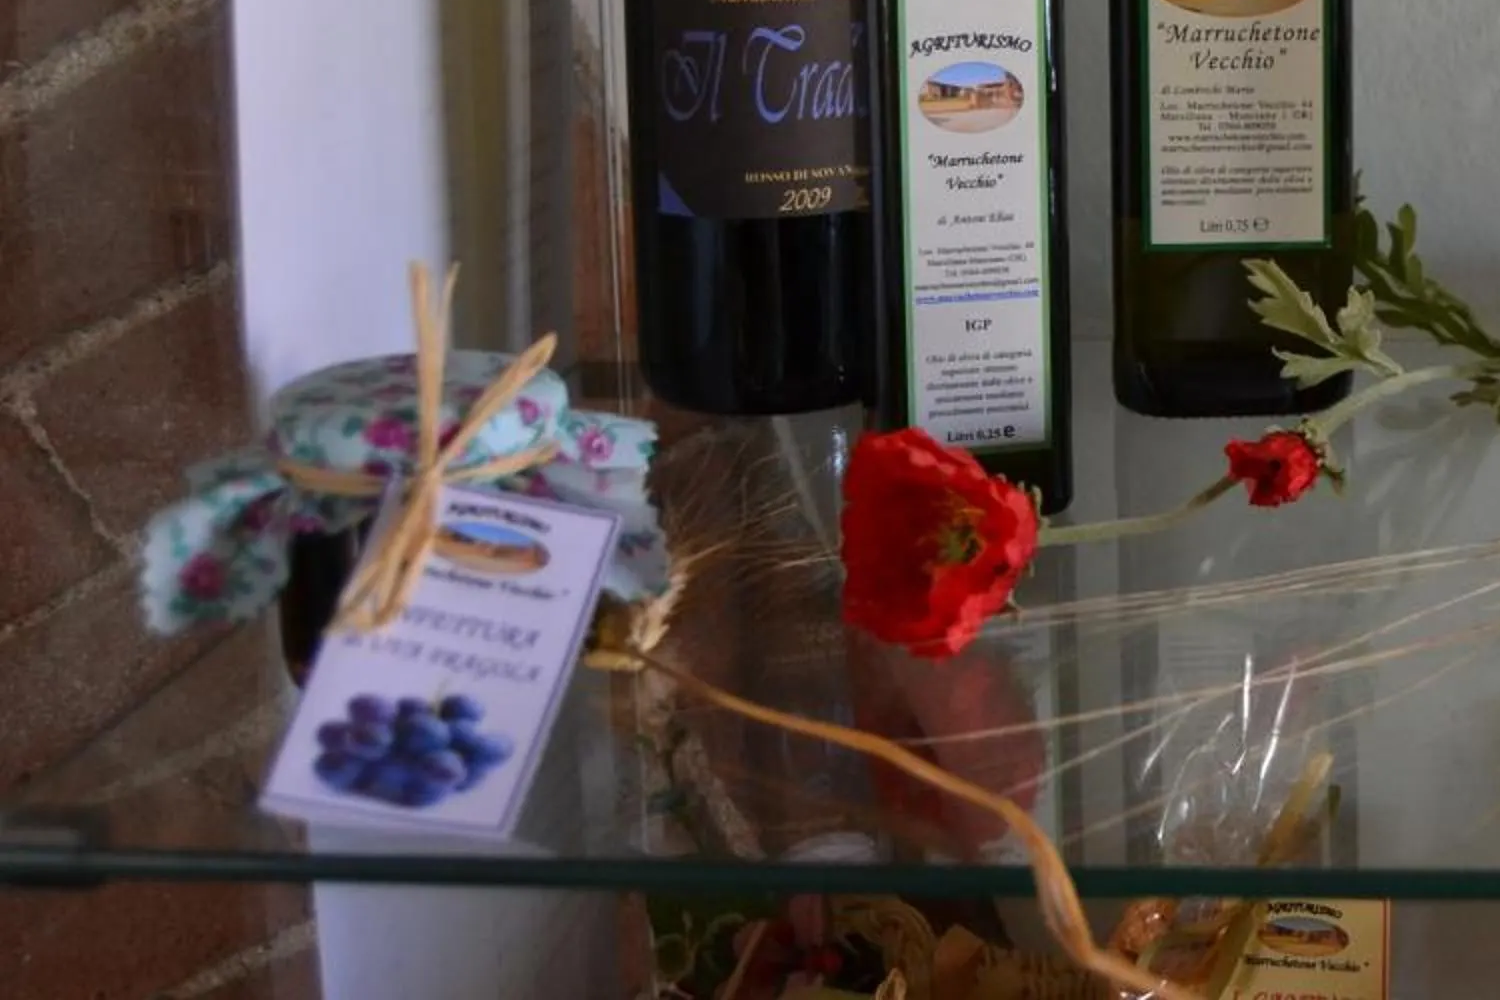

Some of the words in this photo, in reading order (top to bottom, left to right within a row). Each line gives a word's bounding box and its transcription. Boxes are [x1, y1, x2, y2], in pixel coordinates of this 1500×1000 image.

[910, 31, 1033, 58] AGRITURISMO
[779, 184, 833, 212] 2009
[965, 319, 992, 332] IGP
